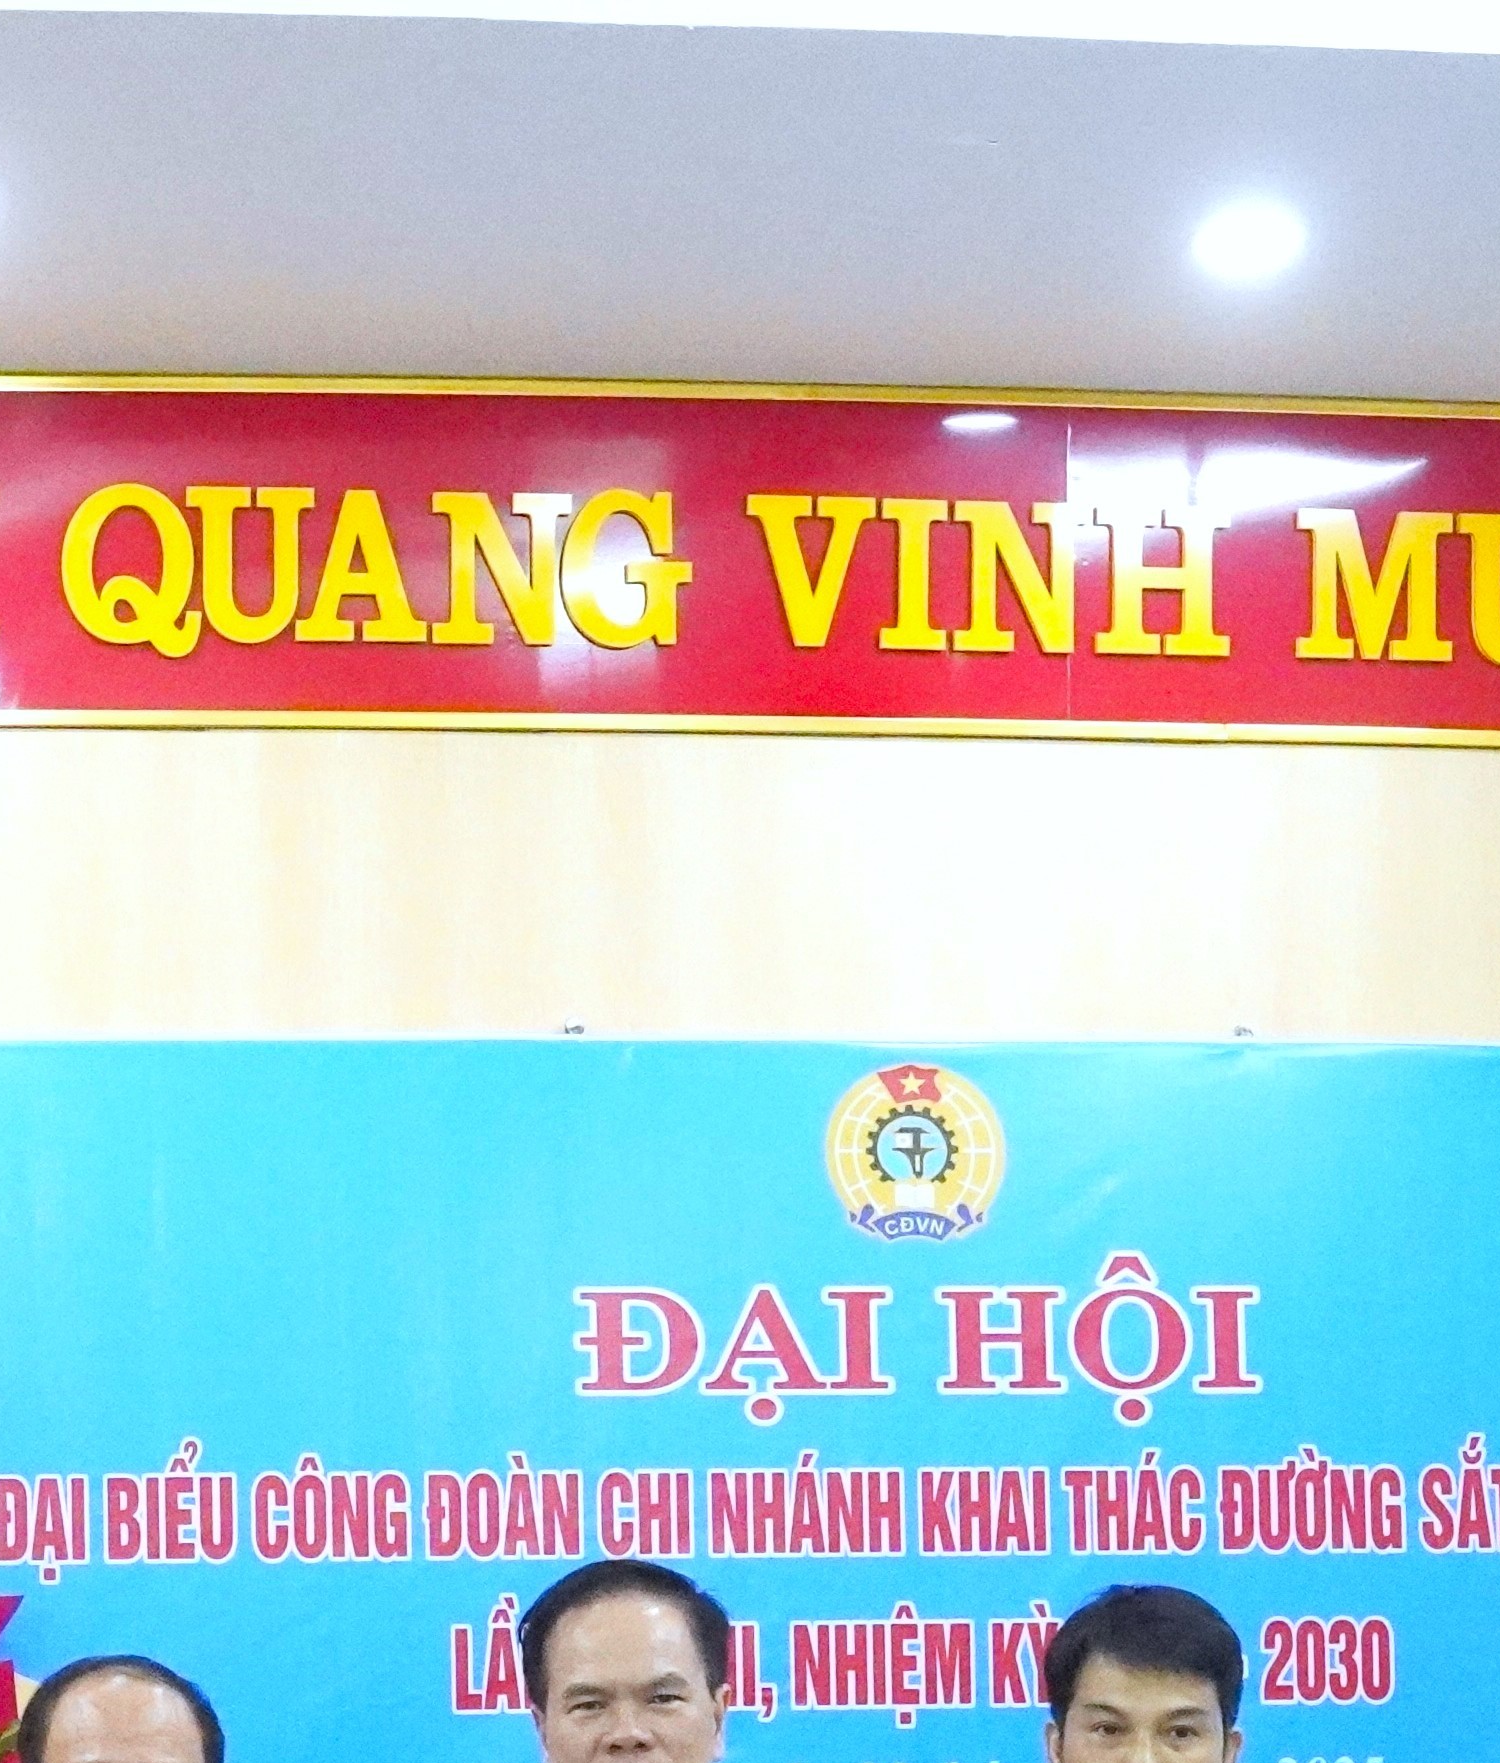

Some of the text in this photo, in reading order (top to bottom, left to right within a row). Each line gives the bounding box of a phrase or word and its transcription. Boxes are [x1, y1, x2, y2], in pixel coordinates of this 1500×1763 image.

[59, 484, 692, 656] QUANG
[747, 494, 1230, 656] VINH
[884, 1216, 946, 1236] CĐVN
[576, 1252, 1259, 1424] ĐẠI HỘI
[104, 1437, 236, 1563] BIỂU
[252, 1453, 408, 1563] CÔNG
[425, 1452, 583, 1561] ĐOÀN
[600, 1470, 693, 1559] CHI
[708, 1449, 902, 1557] NHÁNH
[918, 1466, 1049, 1556] KHAI
[1063, 1449, 1204, 1555] THÁC
[1217, 1444, 1402, 1553] ĐƯỜNG
[452, 1597, 536, 1714] LẦ
[791, 1601, 976, 1727] NHIỆM
[989, 1600, 1062, 1707] KỲ
[1261, 1616, 1394, 1705] 2030
